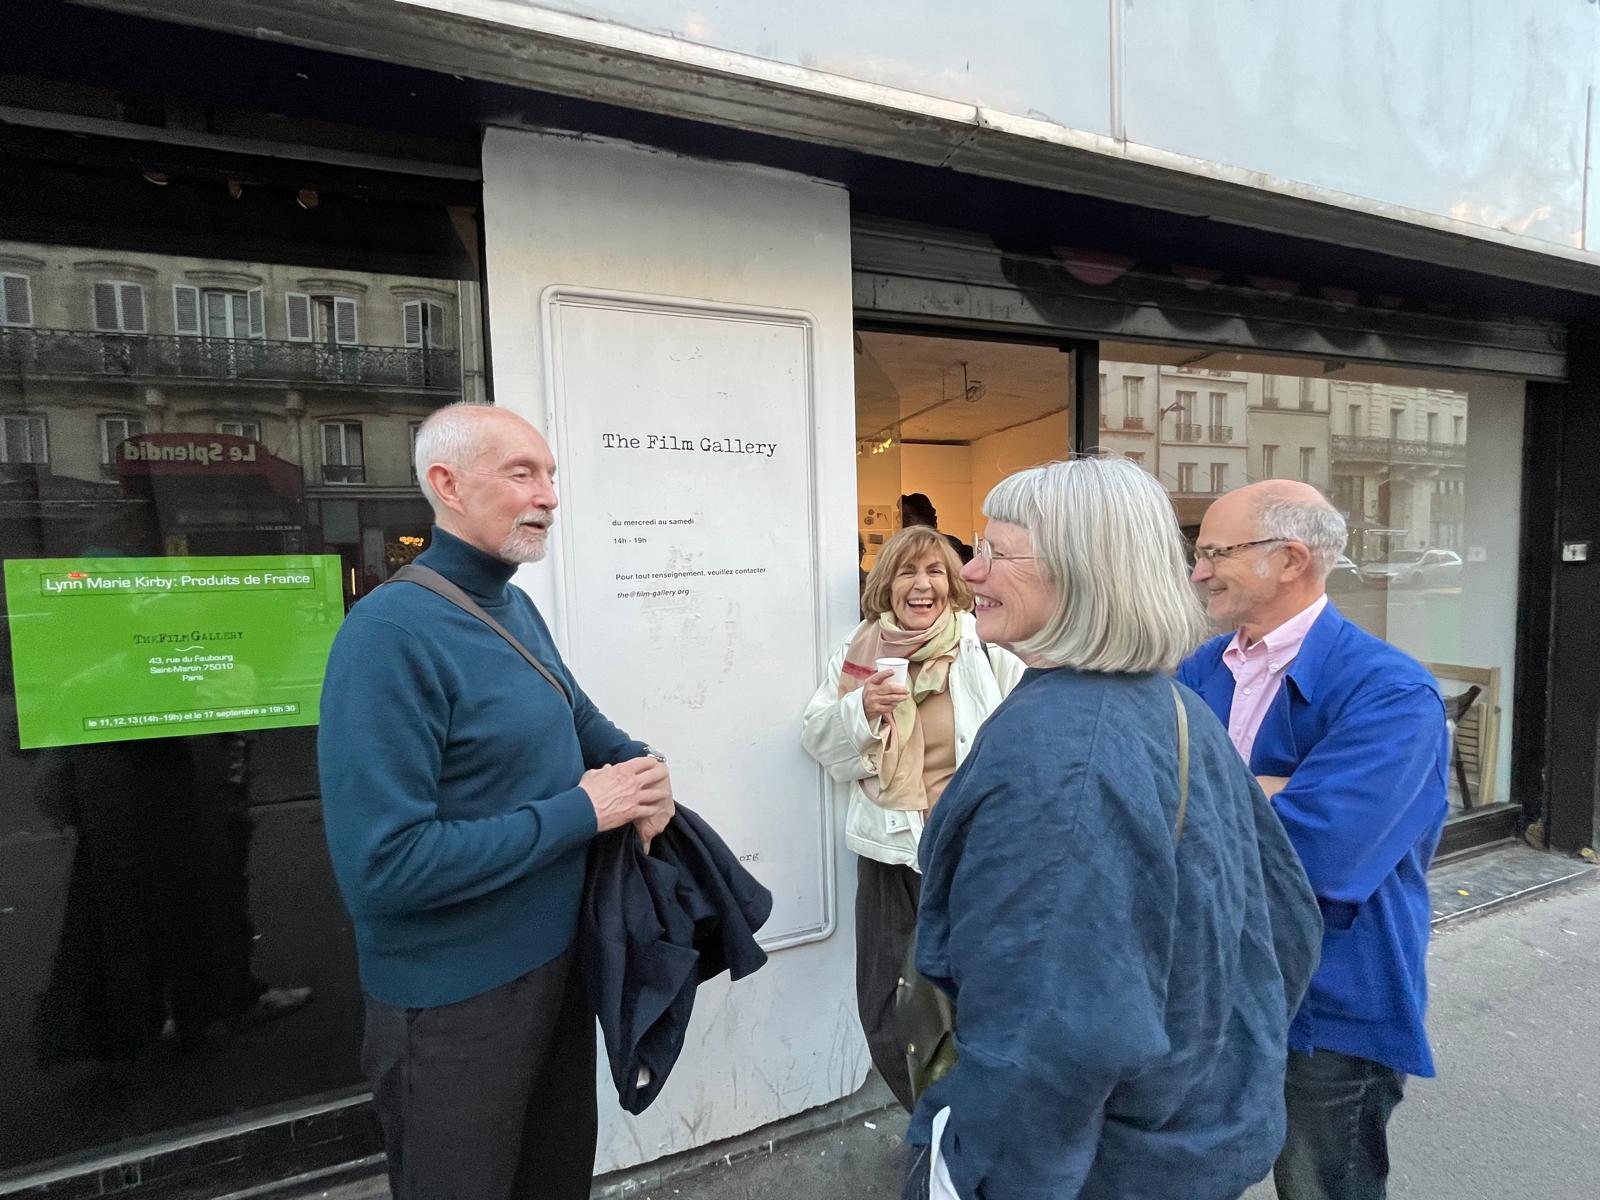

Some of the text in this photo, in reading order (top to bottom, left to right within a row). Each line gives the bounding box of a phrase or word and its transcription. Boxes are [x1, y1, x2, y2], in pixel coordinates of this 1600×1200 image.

[602, 433, 777, 457] The Film Gallery
[624, 518, 656, 526] mercredi
[669, 517, 694, 525] samedi
[615, 566, 766, 581] Pour tout renseignement, veuillez contacter
[46, 573, 310, 592] Lynn Marie Kirby: Produits de France
[149, 657, 164, 665] 43,
[194, 654, 234, 662] Faubourg
[203, 662, 233, 671] 75010
[182, 674, 204, 682] Paris
[216, 708, 259, 717] septembre
[285, 704, 296, 712] 30
